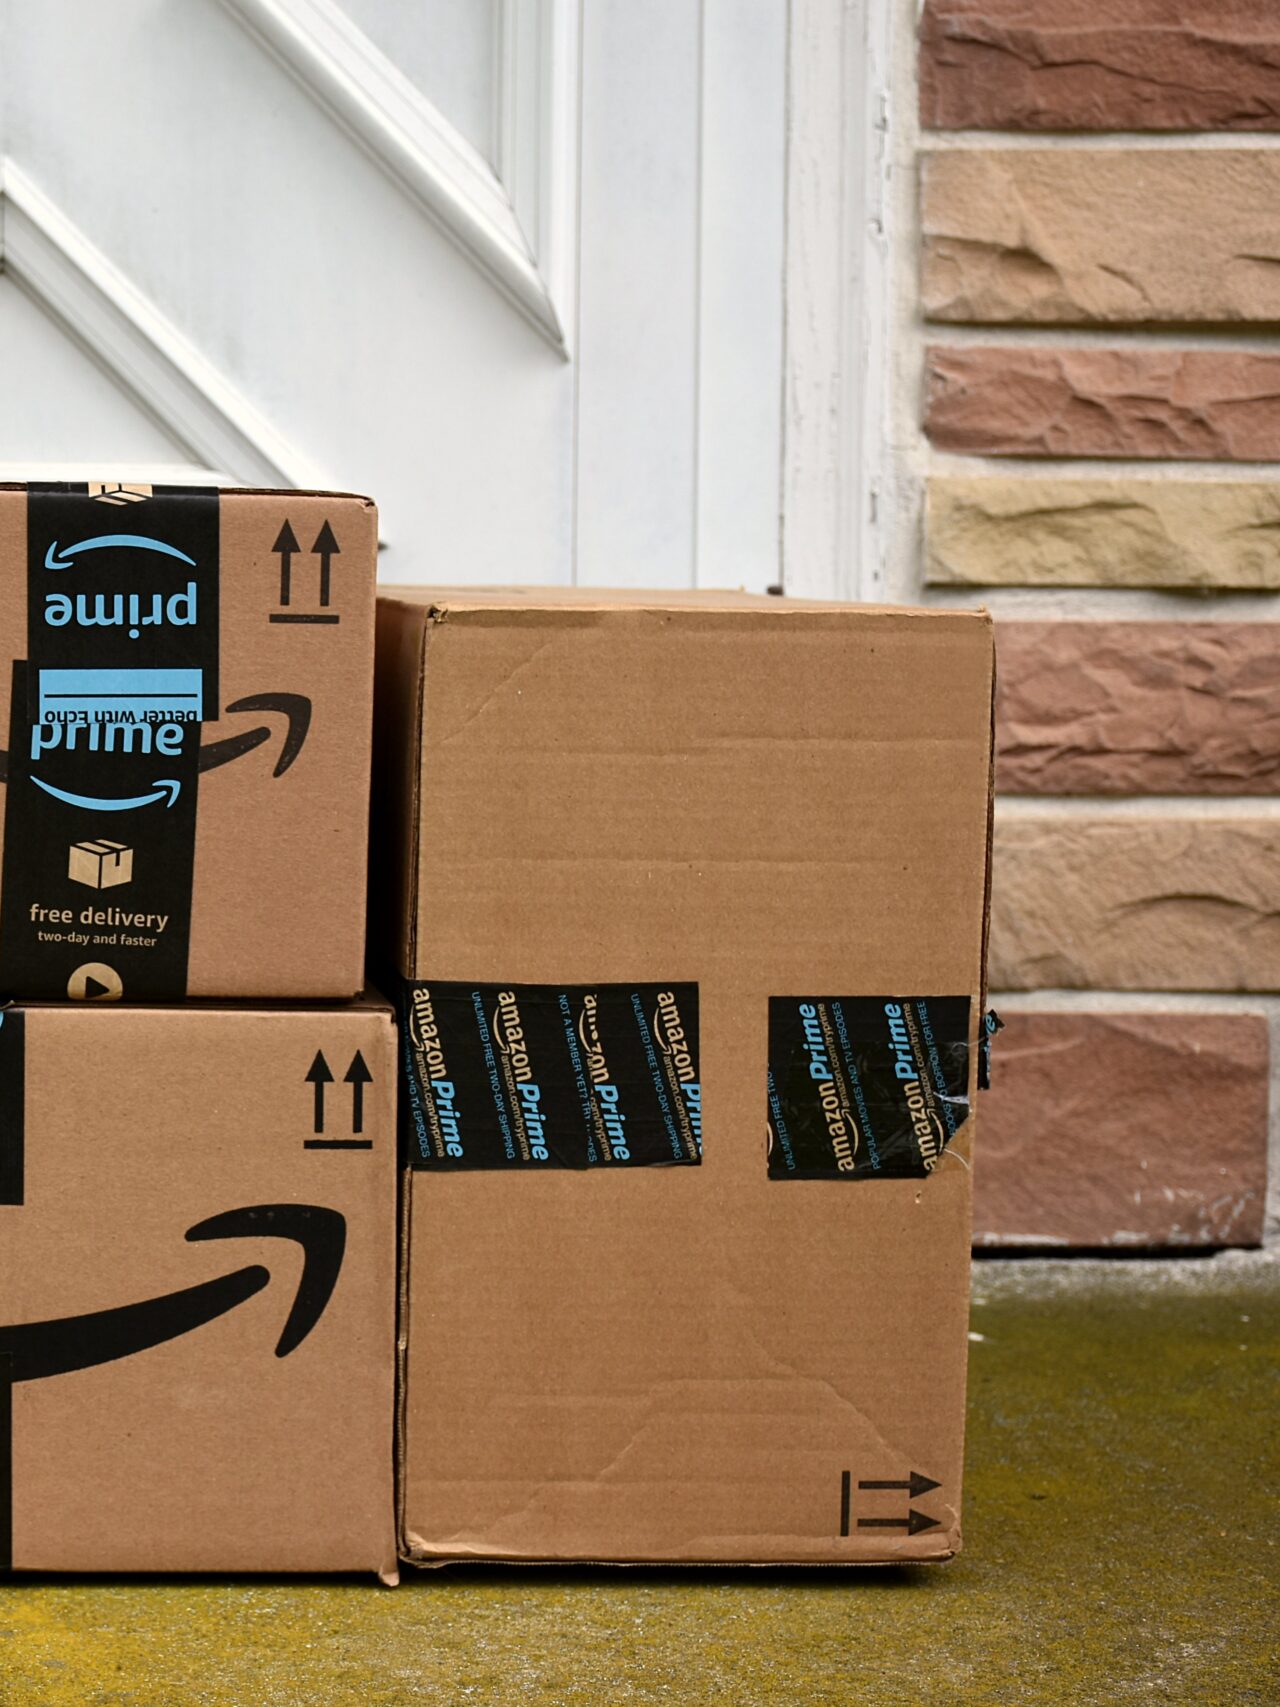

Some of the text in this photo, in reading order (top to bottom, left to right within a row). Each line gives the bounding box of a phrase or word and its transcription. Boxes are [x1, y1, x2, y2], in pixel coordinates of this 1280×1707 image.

[45, 582, 197, 639] prime
[29, 904, 168, 932] free delivery
[38, 931, 157, 946] two-day and faster
[558, 994, 570, 1014] NOT
[562, 1017, 572, 1026] A
[657, 991, 695, 1081] amazon
[916, 1001, 928, 1025] FREE
[922, 1025, 934, 1045] FOR
[412, 988, 463, 1157] amazon Prime
[471, 991, 515, 1159] UNLIMITED FREE TWO-DAY SHIPPING
[497, 991, 548, 1160] amazon Prime
[565, 1027, 581, 1071] MEMBER
[575, 1073, 588, 1098] YET?
[630, 993, 682, 1158] UNLIMITED FREE TWO-DAY SHIPPING
[818, 1003, 850, 1108] amazon.com/tryprime
[831, 1001, 880, 1169] POPULAR MOVIES AND TV EPISODES
[903, 1003, 935, 1107] amazon.com/tryprime
[927, 1046, 945, 1088] BORROW
[415, 1052, 445, 1158] amazon.com/tryprime
[501, 1055, 530, 1161] amazon.com/tryprime
[594, 1085, 630, 1160] Prime
[663, 1056, 698, 1161] amazon.com/tryprime
[769, 1094, 782, 1119] FREE
[798, 1003, 854, 1171] amazon Prime
[884, 1003, 938, 1172] amazon Prime
[413, 1110, 431, 1158] EPISODES
[776, 1120, 795, 1170] UNLIMITED
